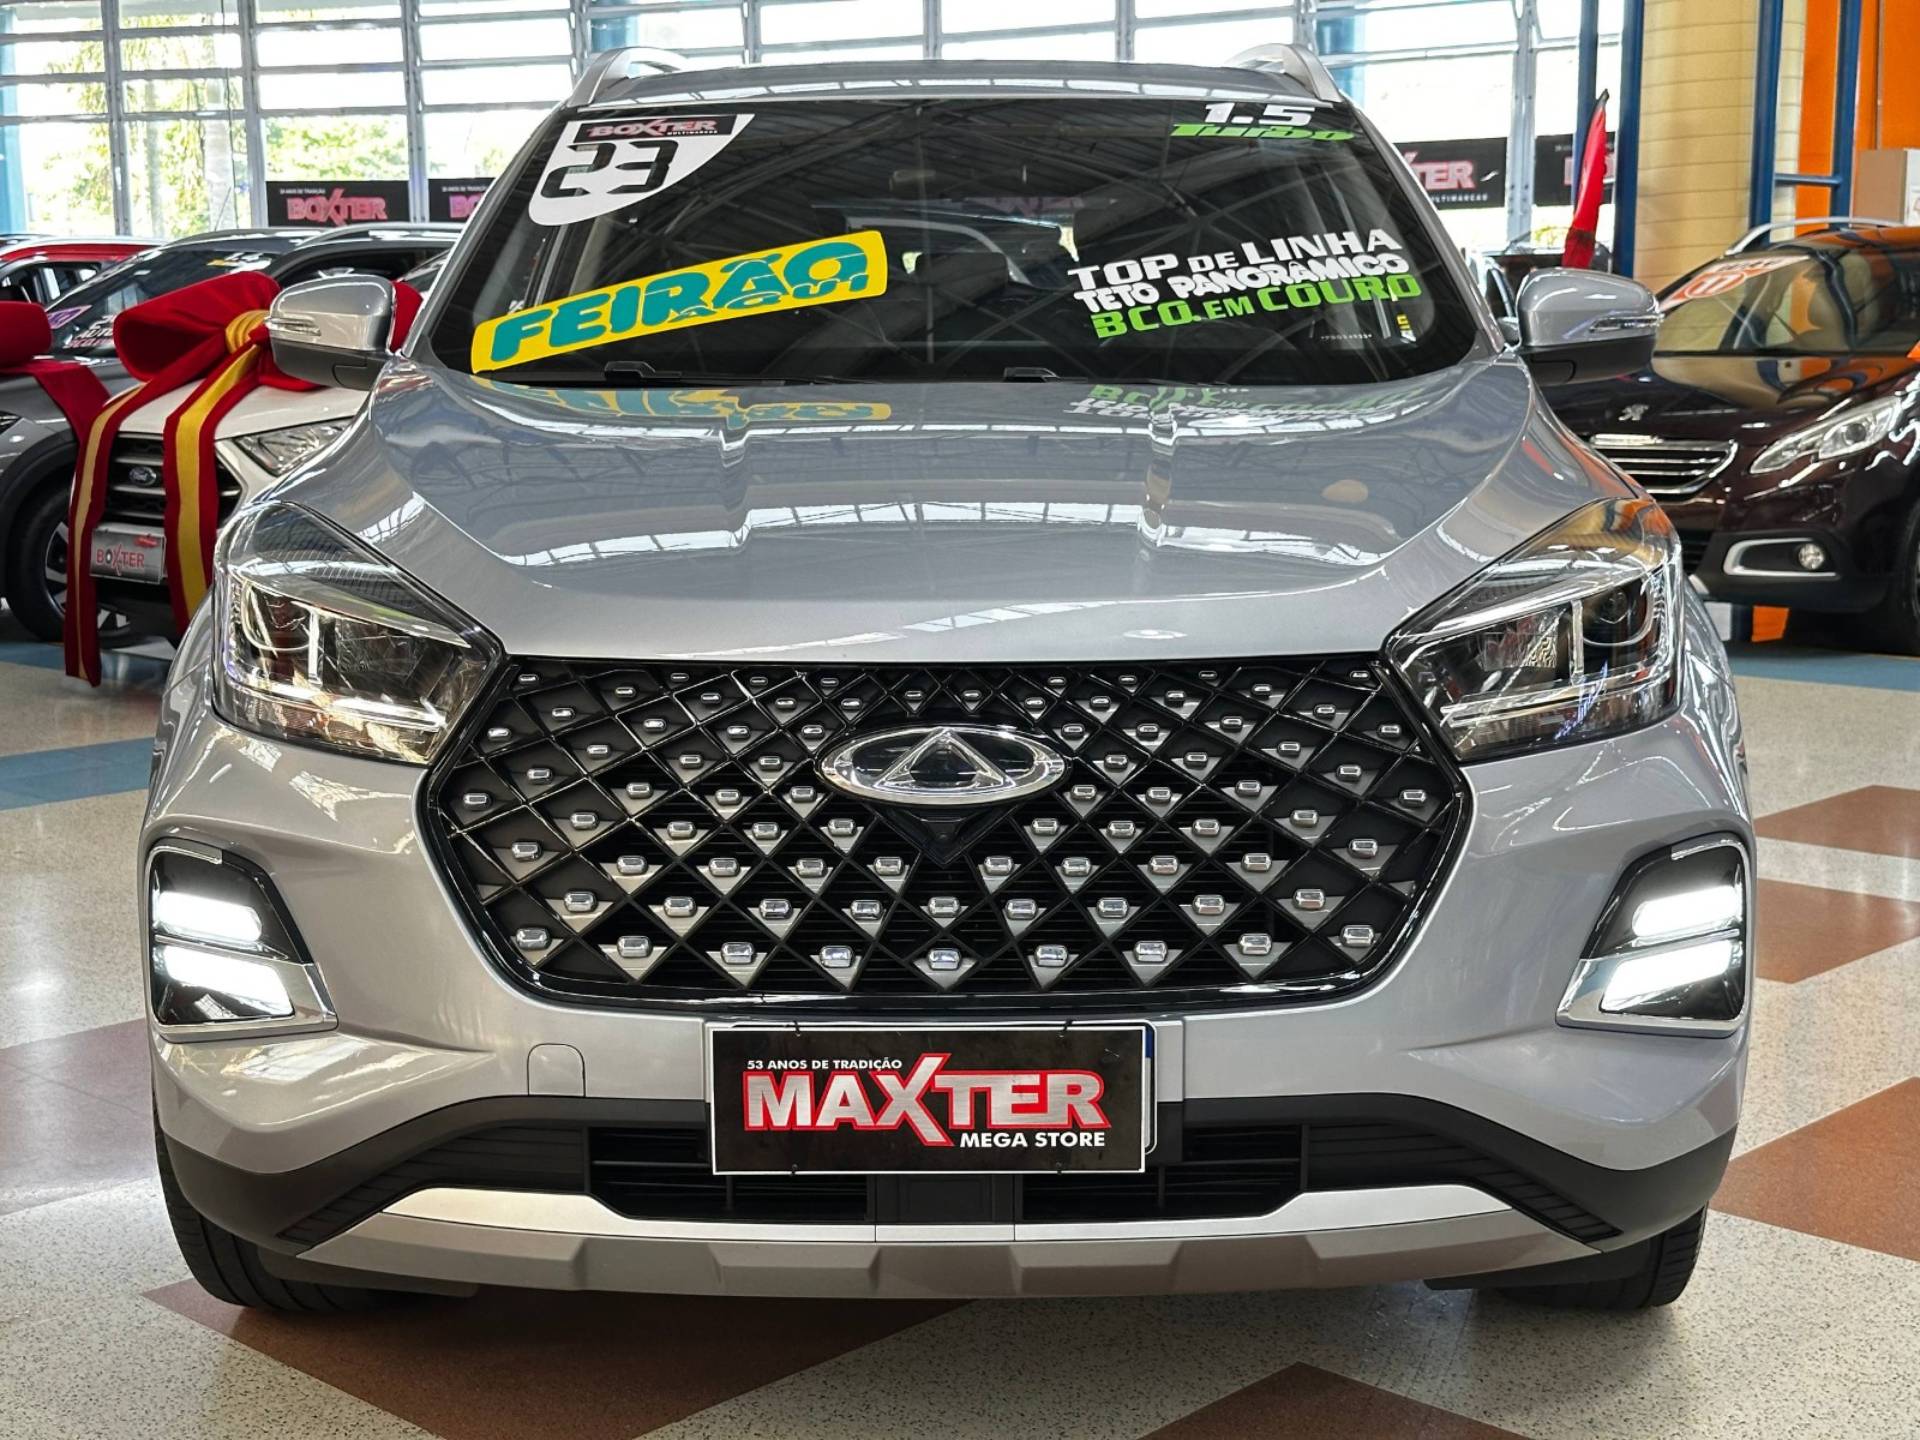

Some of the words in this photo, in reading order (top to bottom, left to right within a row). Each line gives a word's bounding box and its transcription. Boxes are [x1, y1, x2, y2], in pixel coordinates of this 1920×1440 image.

[588, 119, 717, 137] BOXTER
[1205, 103, 1315, 126] 1.5
[541, 140, 678, 198] 23
[1068, 254, 1179, 290] TOP
[1187, 252, 1237, 273] DE
[1241, 229, 1402, 265] LINHA
[1074, 282, 1159, 313] TETO
[1167, 253, 1409, 299] PANORÂMICO
[491, 242, 868, 362] FEIRÃO
[1091, 299, 1201, 338] BCO.
[1204, 296, 1254, 320] EM
[1256, 274, 1421, 309] COURO
[96, 544, 144, 576] BOXTER
[747, 1060, 763, 1069] 53
[767, 1060, 807, 1069] ANOS
[812, 1060, 829, 1069] DE
[833, 1057, 902, 1071] TRADIÇÃO
[743, 1053, 1111, 1147] MAXTER
[960, 1132, 1027, 1147] MEGA
[1036, 1131, 1105, 1147] STORE
